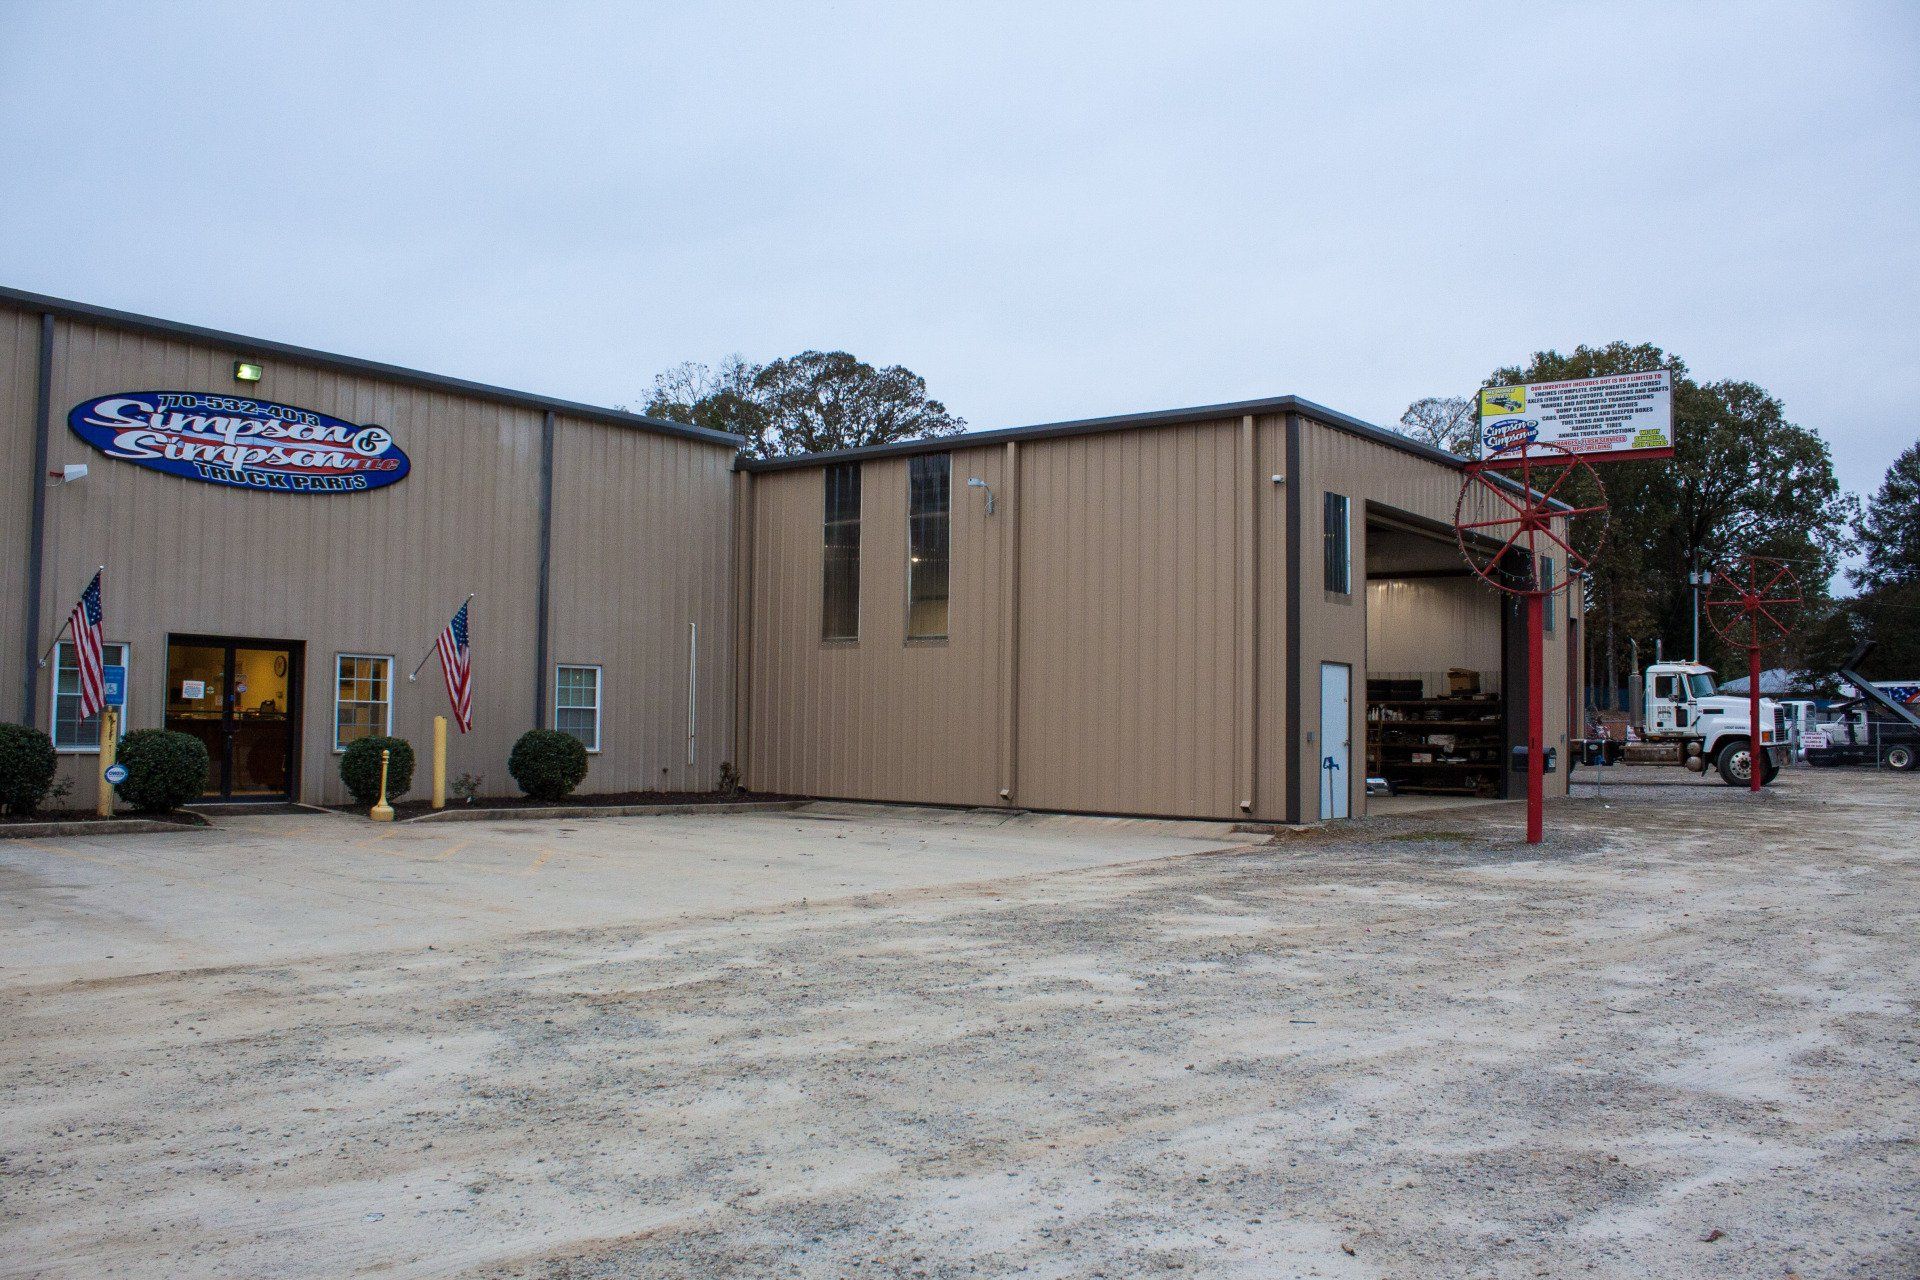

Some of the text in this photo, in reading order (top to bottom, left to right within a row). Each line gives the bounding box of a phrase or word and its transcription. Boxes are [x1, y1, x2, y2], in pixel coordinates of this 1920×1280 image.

[1589, 384, 1627, 392] COMPONENTS
[1608, 394, 1654, 402] TRANSMISSIONS
[84, 398, 354, 446] Simpson
[157, 394, 320, 427] 770-532-4013
[1482, 421, 1527, 439] Simpson
[105, 430, 400, 472] Simpson LLC
[194, 461, 367, 490] TRUCK PARTS
